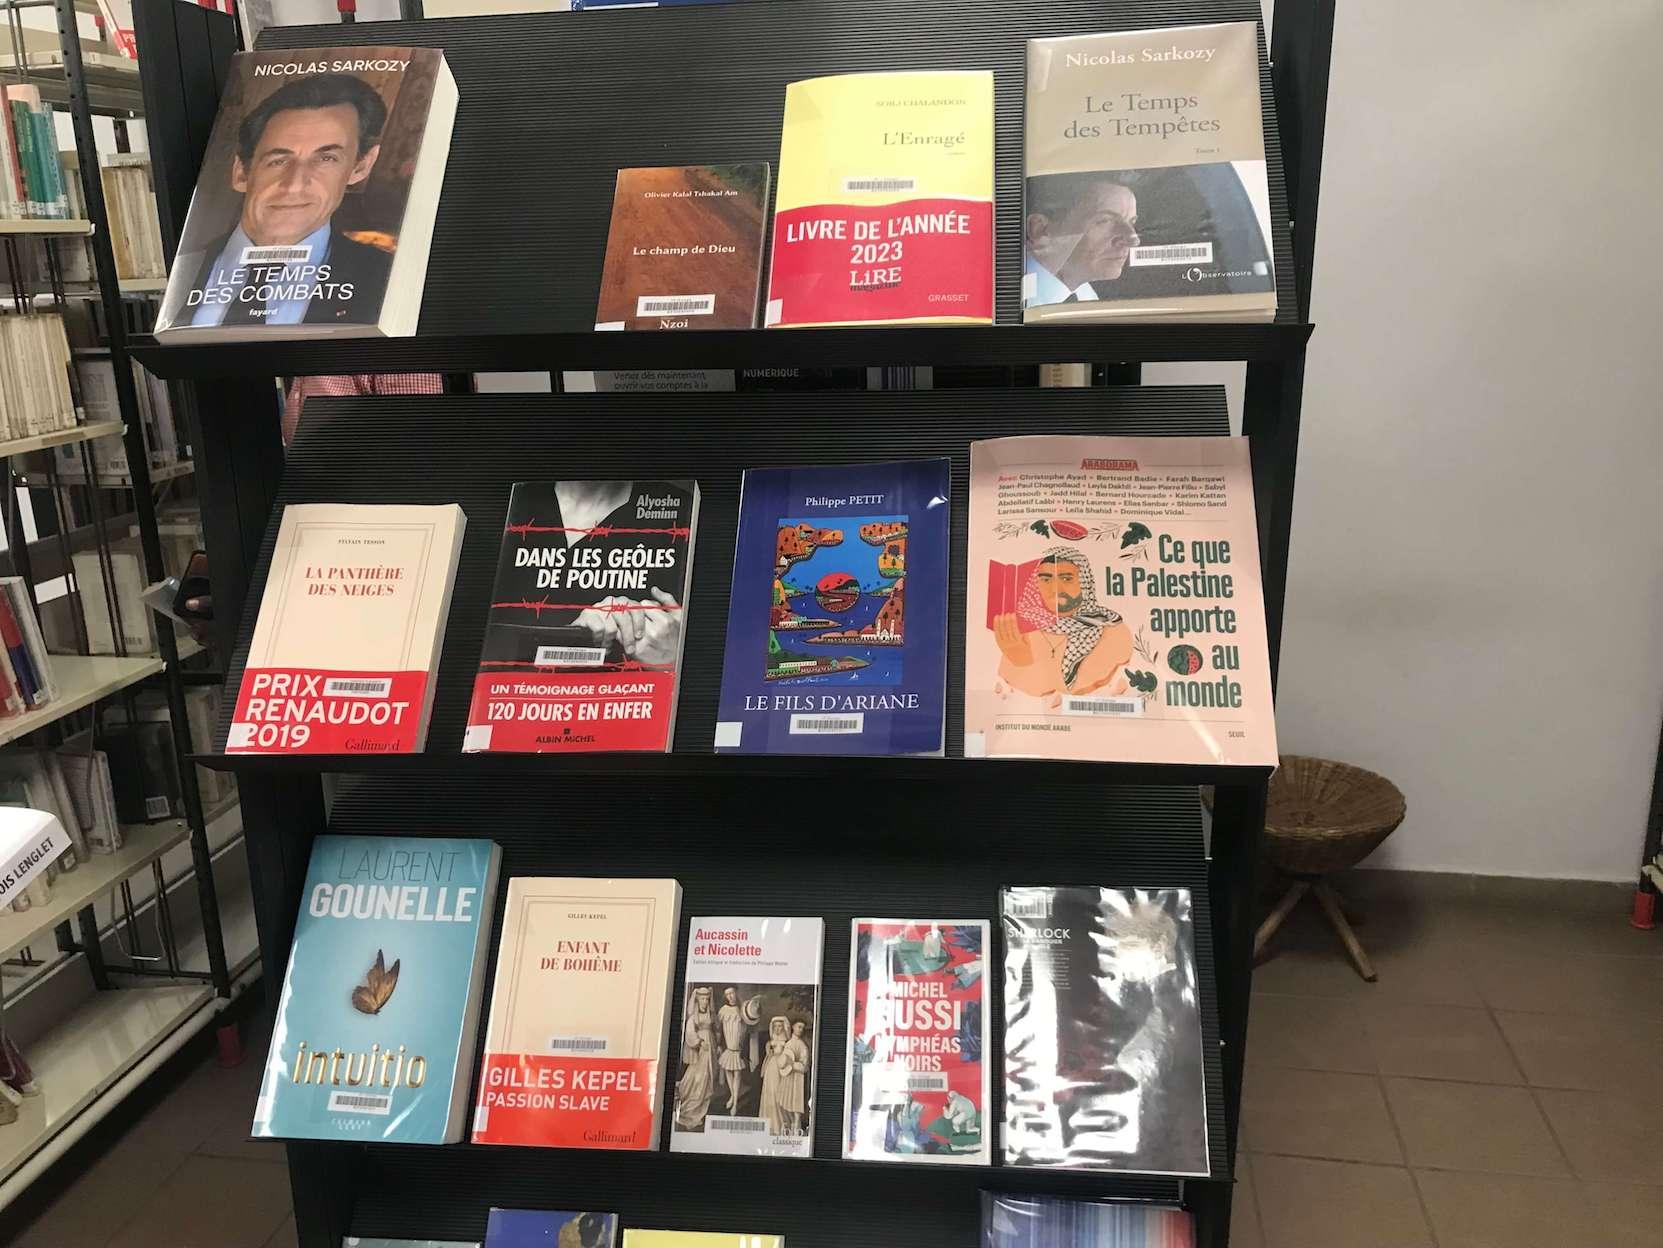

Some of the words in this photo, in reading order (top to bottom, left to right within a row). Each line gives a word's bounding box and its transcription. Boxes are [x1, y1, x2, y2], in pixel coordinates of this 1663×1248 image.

[1066, 50, 1135, 67] Nicolas
[1141, 46, 1216, 63] Sarkozy
[254, 61, 328, 77] NICOLAS
[331, 59, 411, 73] SARKOZY
[1085, 96, 1113, 113] Le
[1121, 93, 1199, 114] Temps
[1064, 120, 1101, 139] des
[1109, 116, 1221, 140] Tempêtes
[883, 131, 965, 148] L'Enragé
[787, 219, 847, 243] LIVRE
[854, 220, 881, 241] DE
[888, 210, 971, 239] L'ANNÉE
[633, 247, 646, 256] Le
[649, 245, 688, 257] champ
[692, 246, 706, 254] de
[708, 244, 736, 254] Dieu
[850, 240, 903, 264] 2023
[218, 269, 247, 285] LE
[253, 264, 332, 283] TEMPS
[187, 287, 233, 306] DES
[239, 283, 354, 303] COMBATS
[928, 294, 970, 302] GRASSET
[249, 308, 279, 318] fayard
[659, 318, 689, 331] Nzoi
[1019, 473, 1065, 481] Christophe
[636, 494, 681, 510] Alyosha
[805, 497, 846, 507] Philippe
[849, 494, 884, 505] PETIT
[1207, 500, 1227, 508] Sand
[636, 508, 678, 520] Deminn
[1120, 509, 1163, 517] Dominique
[514, 547, 566, 568] DANS
[571, 549, 602, 568] LES
[608, 543, 676, 568] GEÔLES
[1158, 534, 1185, 563] Ce
[1191, 540, 1231, 568] que
[305, 567, 322, 579] LA
[327, 564, 404, 580] PANTHÈRE
[536, 569, 561, 589] DE
[566, 569, 649, 589] POUTINE
[308, 583, 337, 596] DES
[341, 584, 395, 597] NEIGES
[1105, 566, 1125, 596] la
[1131, 567, 1234, 598] Palestine
[1150, 605, 1237, 639] apporte
[1211, 643, 1240, 670] au
[252, 674, 322, 697] PRIX
[490, 685, 510, 694] UN
[513, 681, 595, 695] TÉMOIGNAGE
[598, 683, 655, 696] GLAÇANT
[1165, 674, 1243, 708] monde
[744, 695, 769, 711] LE
[774, 695, 815, 711] FILS
[821, 693, 920, 711] D'ARIANE
[245, 698, 409, 725] RENAUDOT
[487, 702, 515, 720] 120
[518, 702, 573, 721] JOURS
[577, 703, 600, 721] EN
[603, 702, 654, 720] ENFER
[246, 723, 311, 748] 2019
[995, 723, 1021, 731] INSTITUT
[344, 738, 400, 751] Gallimad
[13, 837, 54, 879] LENGLET
[338, 848, 463, 882] LAURENT
[309, 882, 477, 922] GOUNELLE
[695, 928, 749, 941] Aucassin
[1007, 927, 1071, 939] SHRLOCK
[557, 940, 610, 954] ENFANT
[694, 946, 705, 955] et
[708, 943, 762, 957] Nicolette
[540, 958, 560, 970] DE
[563, 955, 622, 972] BOHÊME
[892, 982, 948, 999] MICHEL
[293, 1041, 427, 1089] intuitio
[489, 1067, 566, 1089] GILLES
[571, 1070, 642, 1091] KEPEL
[486, 1092, 555, 1109] PASSION
[559, 1095, 610, 1111] SLAVE
